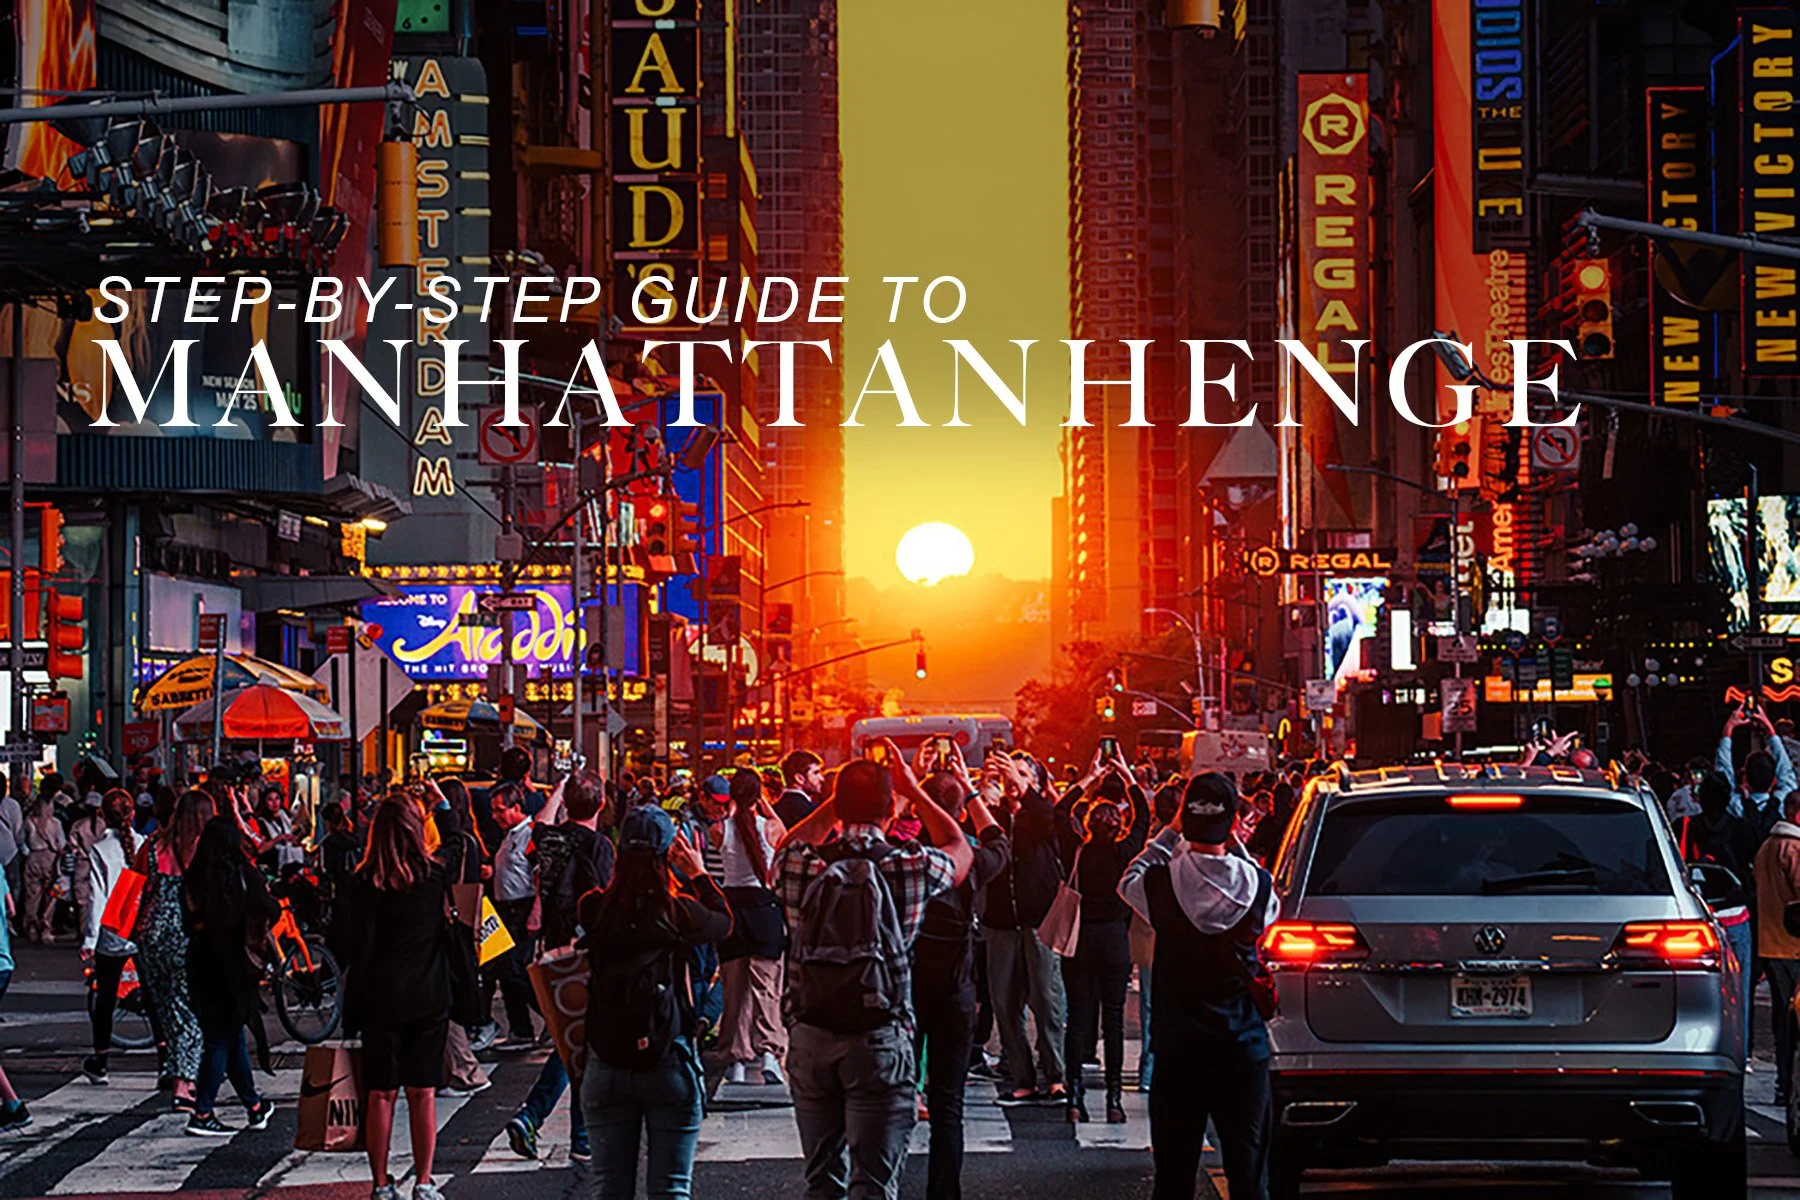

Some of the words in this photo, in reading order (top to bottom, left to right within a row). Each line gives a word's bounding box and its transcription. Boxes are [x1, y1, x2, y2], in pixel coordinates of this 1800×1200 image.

[1477, 105, 1522, 119] THE
[1752, 24, 1796, 233] VICTORY
[1660, 102, 1699, 233] CTORY
[413, 59, 455, 497] AMSTERDAM
[1313, 174, 1358, 374] REGAL
[1755, 265, 1797, 363] NEW
[1662, 315, 1700, 403] NEW
[429, 594, 448, 606] TO
[1290, 553, 1391, 570] REGAL
[392, 589, 588, 662] Aladdi
